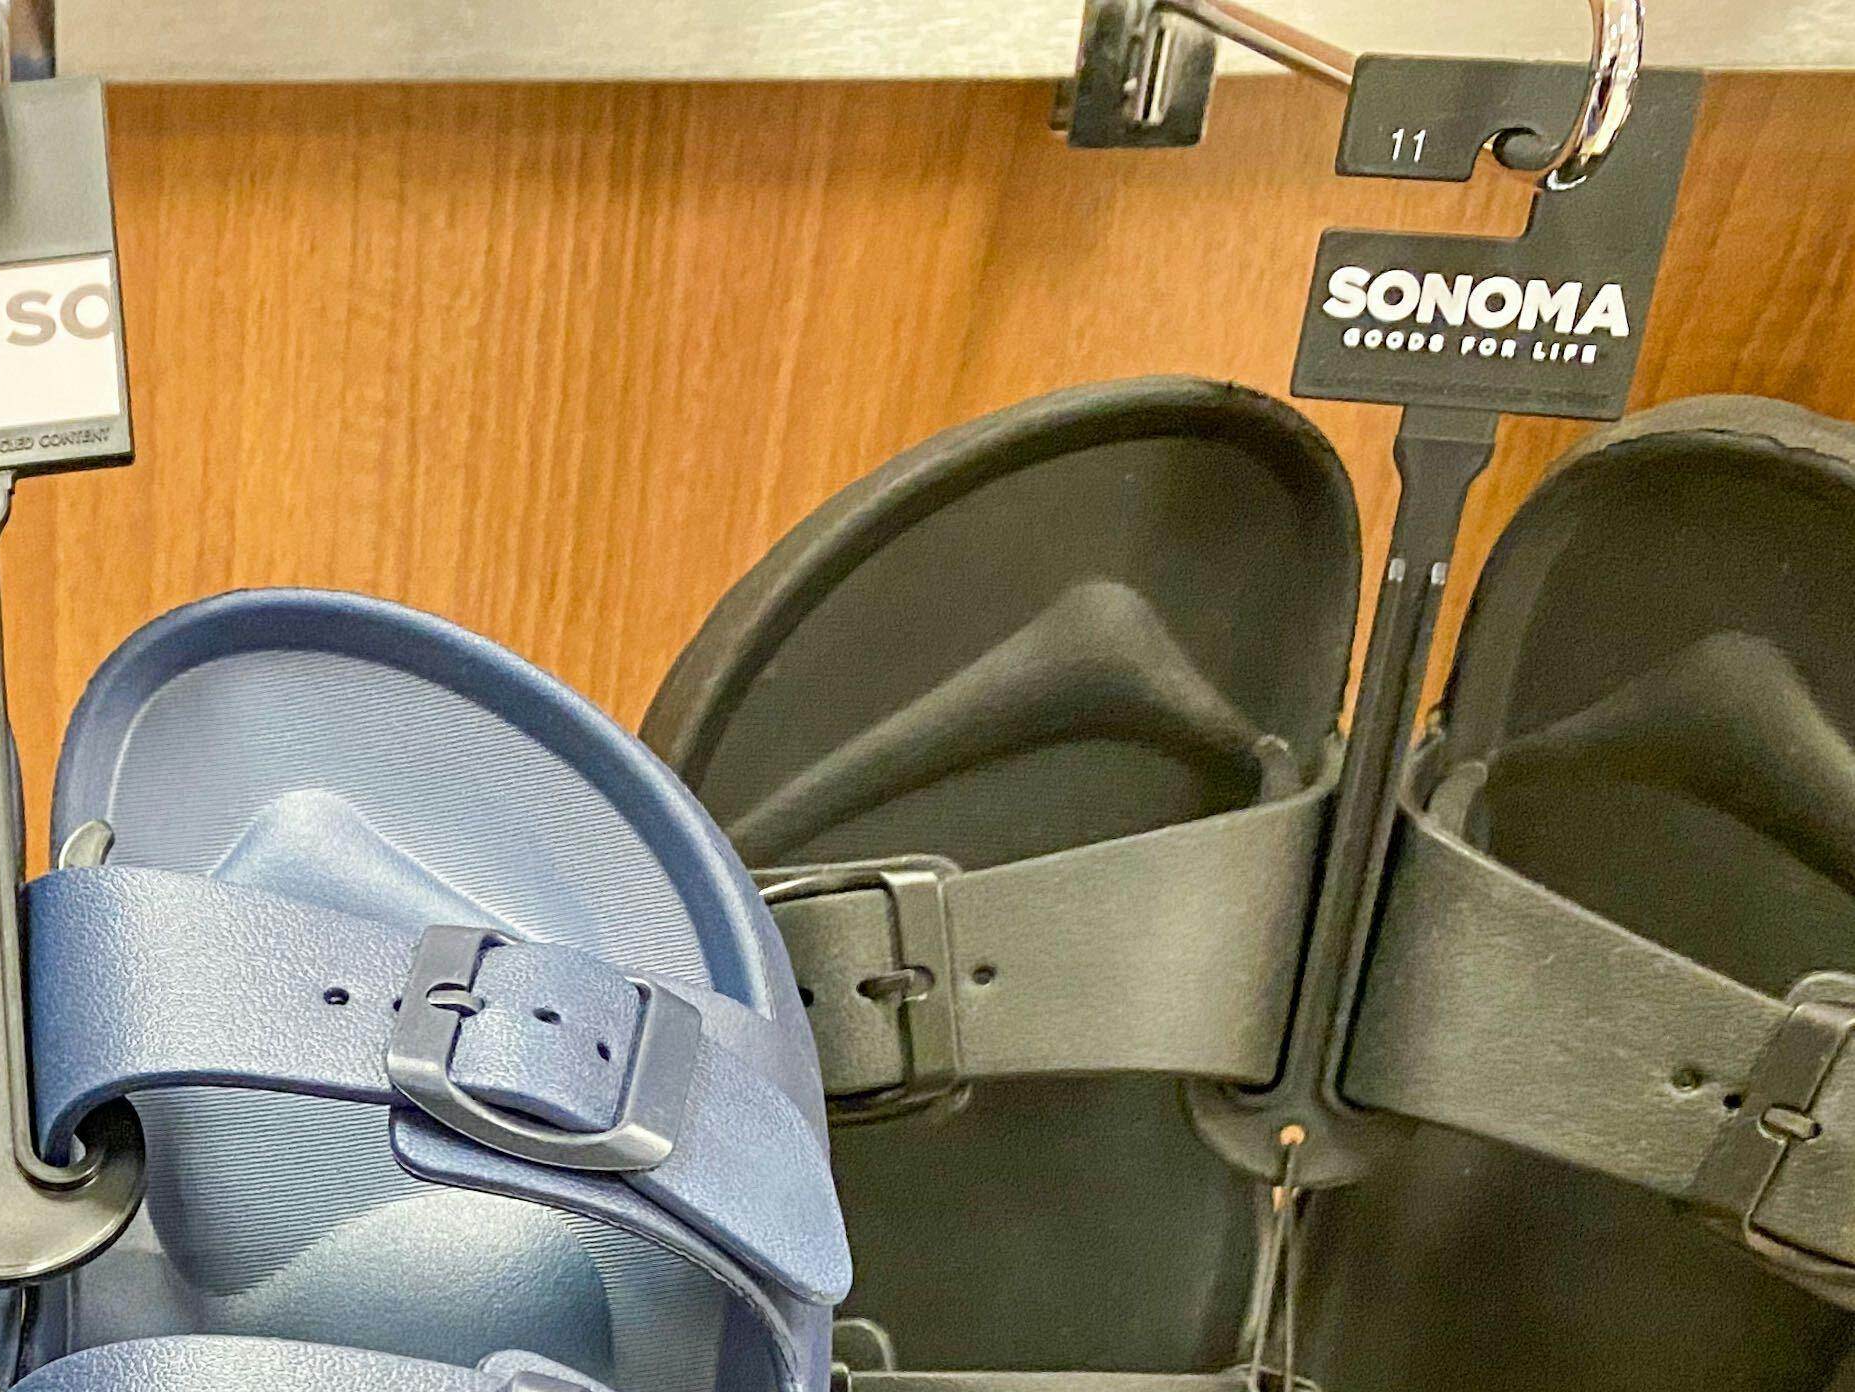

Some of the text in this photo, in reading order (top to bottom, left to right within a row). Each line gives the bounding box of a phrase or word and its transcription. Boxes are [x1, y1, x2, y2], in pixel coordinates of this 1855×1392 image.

[1391, 128, 1427, 163] 11
[1322, 266, 1630, 337] SONOMA
[1343, 327, 1598, 364] GOODS FOR LIFE
[40, 427, 111, 449] CONTENT
